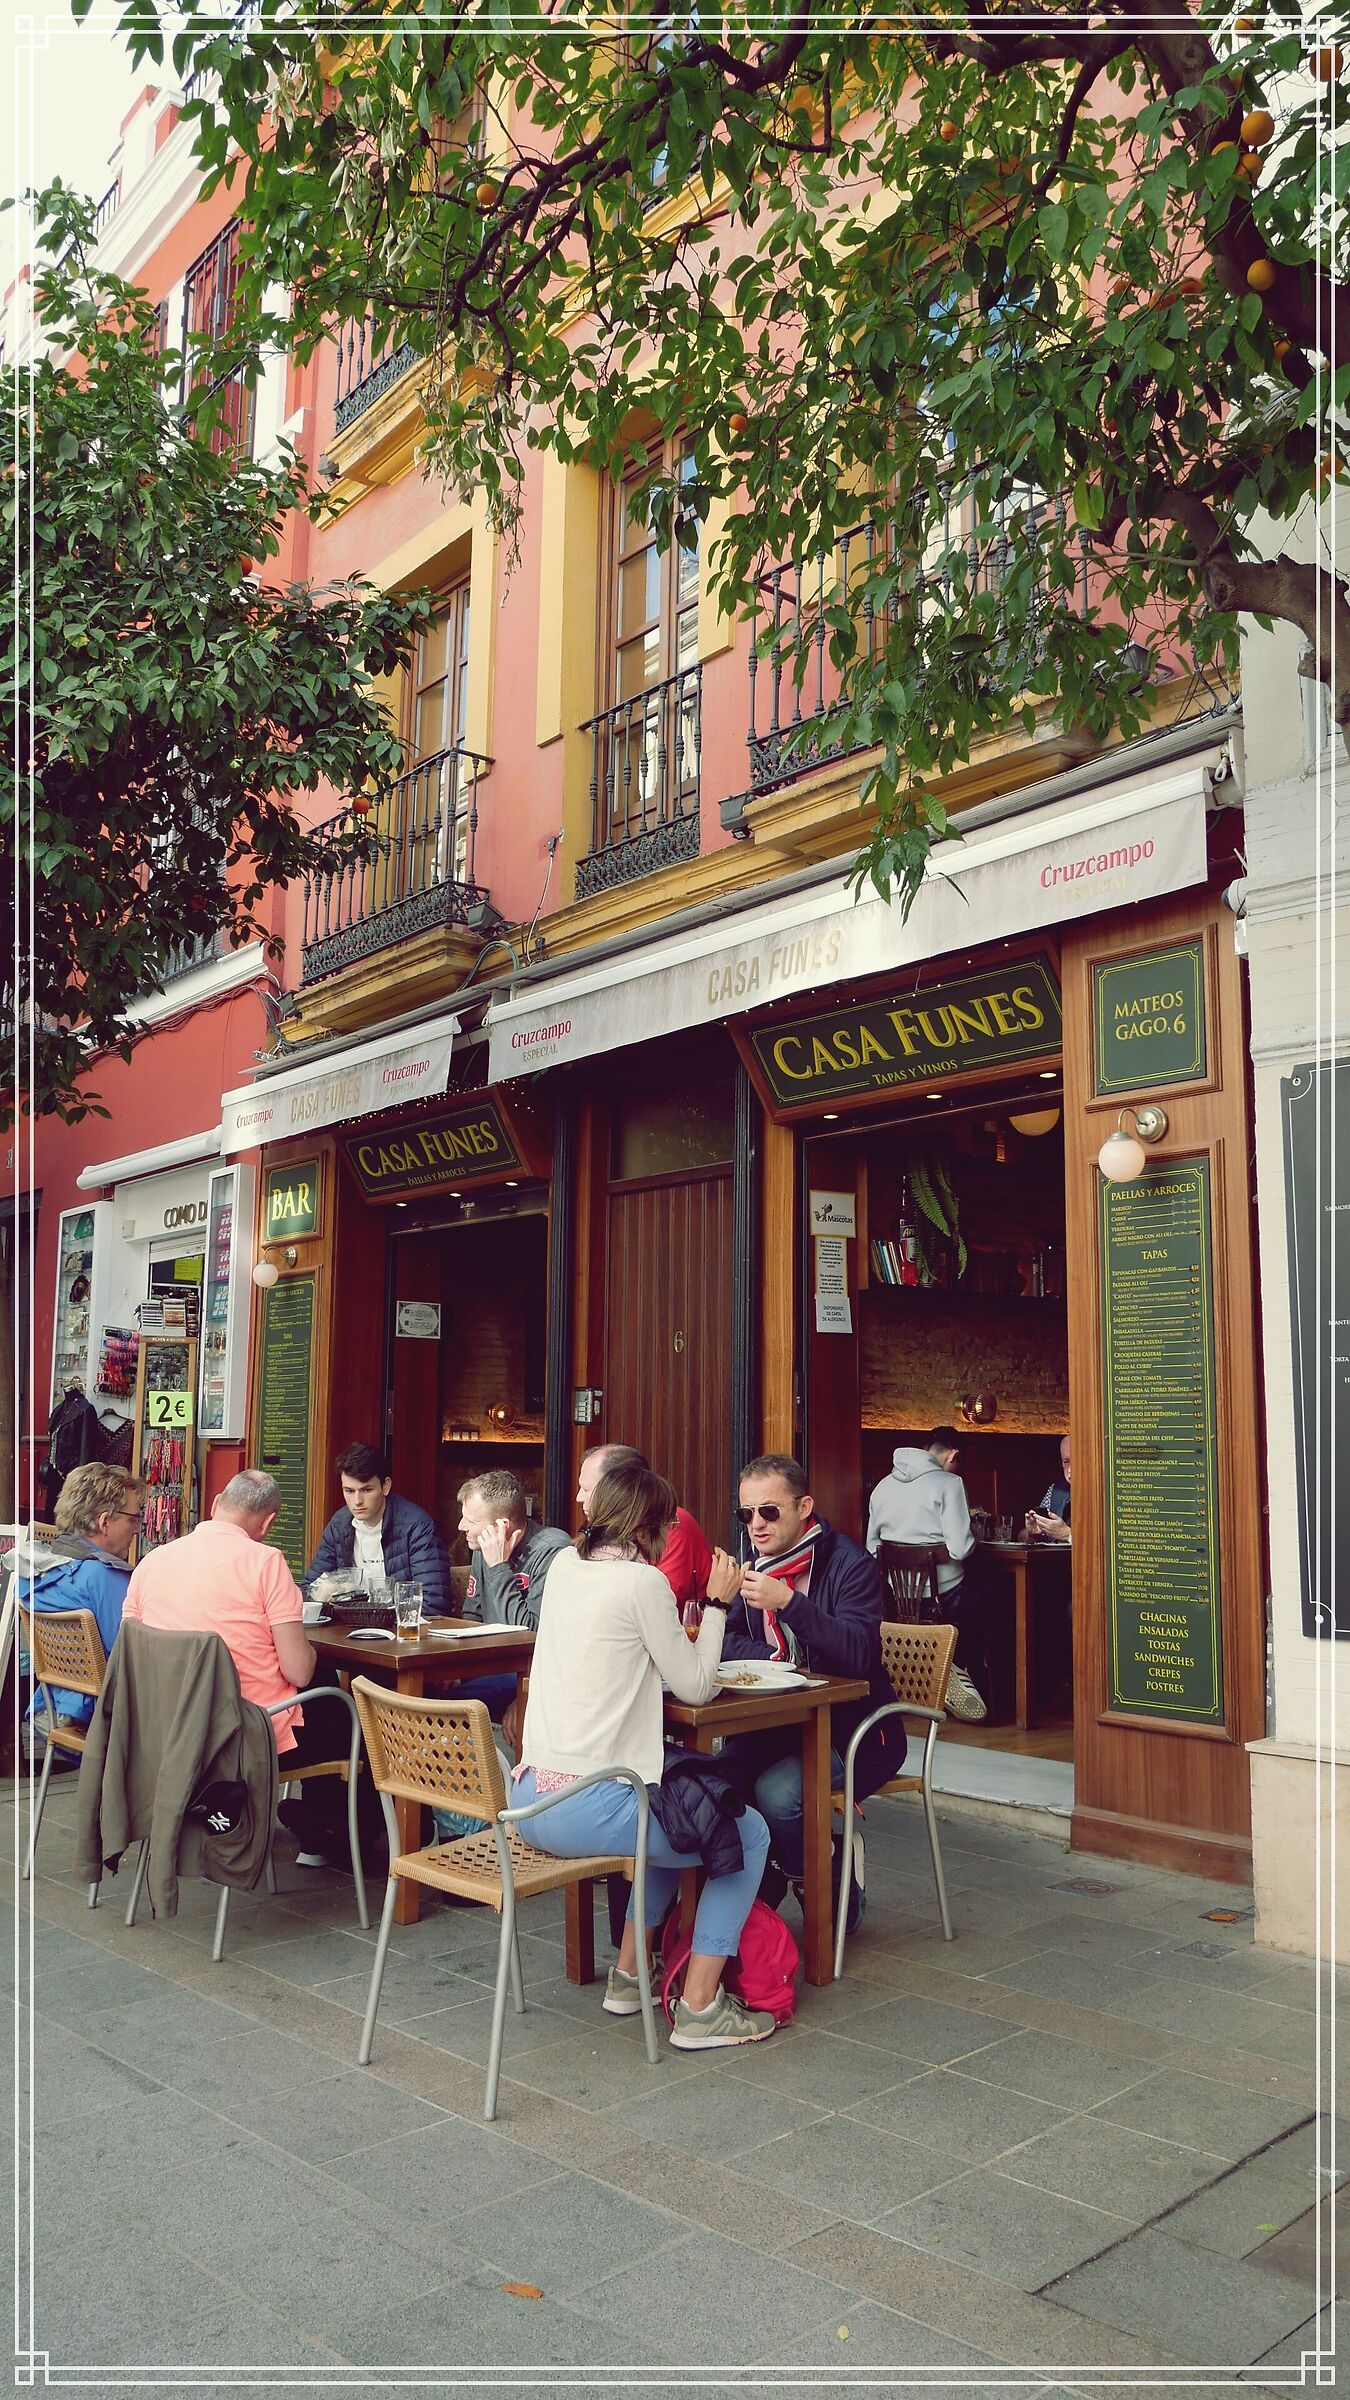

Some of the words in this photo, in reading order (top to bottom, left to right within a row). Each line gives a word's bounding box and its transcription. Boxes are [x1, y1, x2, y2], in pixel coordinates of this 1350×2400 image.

[1040, 837, 1155, 888] Cruzcampo
[707, 956, 760, 1006] CASA
[768, 930, 841, 985] FUNES
[1114, 990, 1184, 1020] MATEOS
[511, 1020, 572, 1049] Cruzcampo
[772, 1025, 895, 1080] CASA
[885, 986, 1046, 1057] FUNES
[1115, 1017, 1171, 1041] GAGO,
[1173, 1013, 1187, 1035] 6
[523, 1044, 558, 1062] ESPECIAL
[382, 1059, 430, 1084] Cruzcampo
[872, 1069, 907, 1086] TAPAS
[908, 1066, 918, 1077] Y
[919, 1059, 958, 1074] VINOS
[290, 1092, 319, 1124] CASA
[324, 1076, 361, 1111] FUNES
[236, 1108, 274, 1129] Cruzcampo
[358, 1140, 424, 1178] CASA
[416, 1120, 499, 1165] FUNES
[407, 1174, 432, 1186] PAELLAS
[437, 1167, 467, 1180] ARROCES
[271, 1182, 312, 1221] BAR
[1111, 1189, 1145, 1201] PAELLAS
[1154, 1183, 1196, 1196] ARROCES
[164, 1203, 197, 1228] COMO
[198, 1200, 208, 1220] D
[828, 1215, 853, 1224] Mascotas
[1141, 1249, 1168, 1260] TAPAS
[674, 1330, 684, 1353] 6
[1140, 1612, 1187, 1624] CHACINAS
[1139, 1625, 1189, 1638] ENSALADAS
[1148, 1640, 1181, 1651] TOSTAS
[1134, 1652, 1195, 1667] SANDWICHES
[1148, 1667, 1181, 1679] CREPES
[1146, 1681, 1184, 1694] POSTRES
